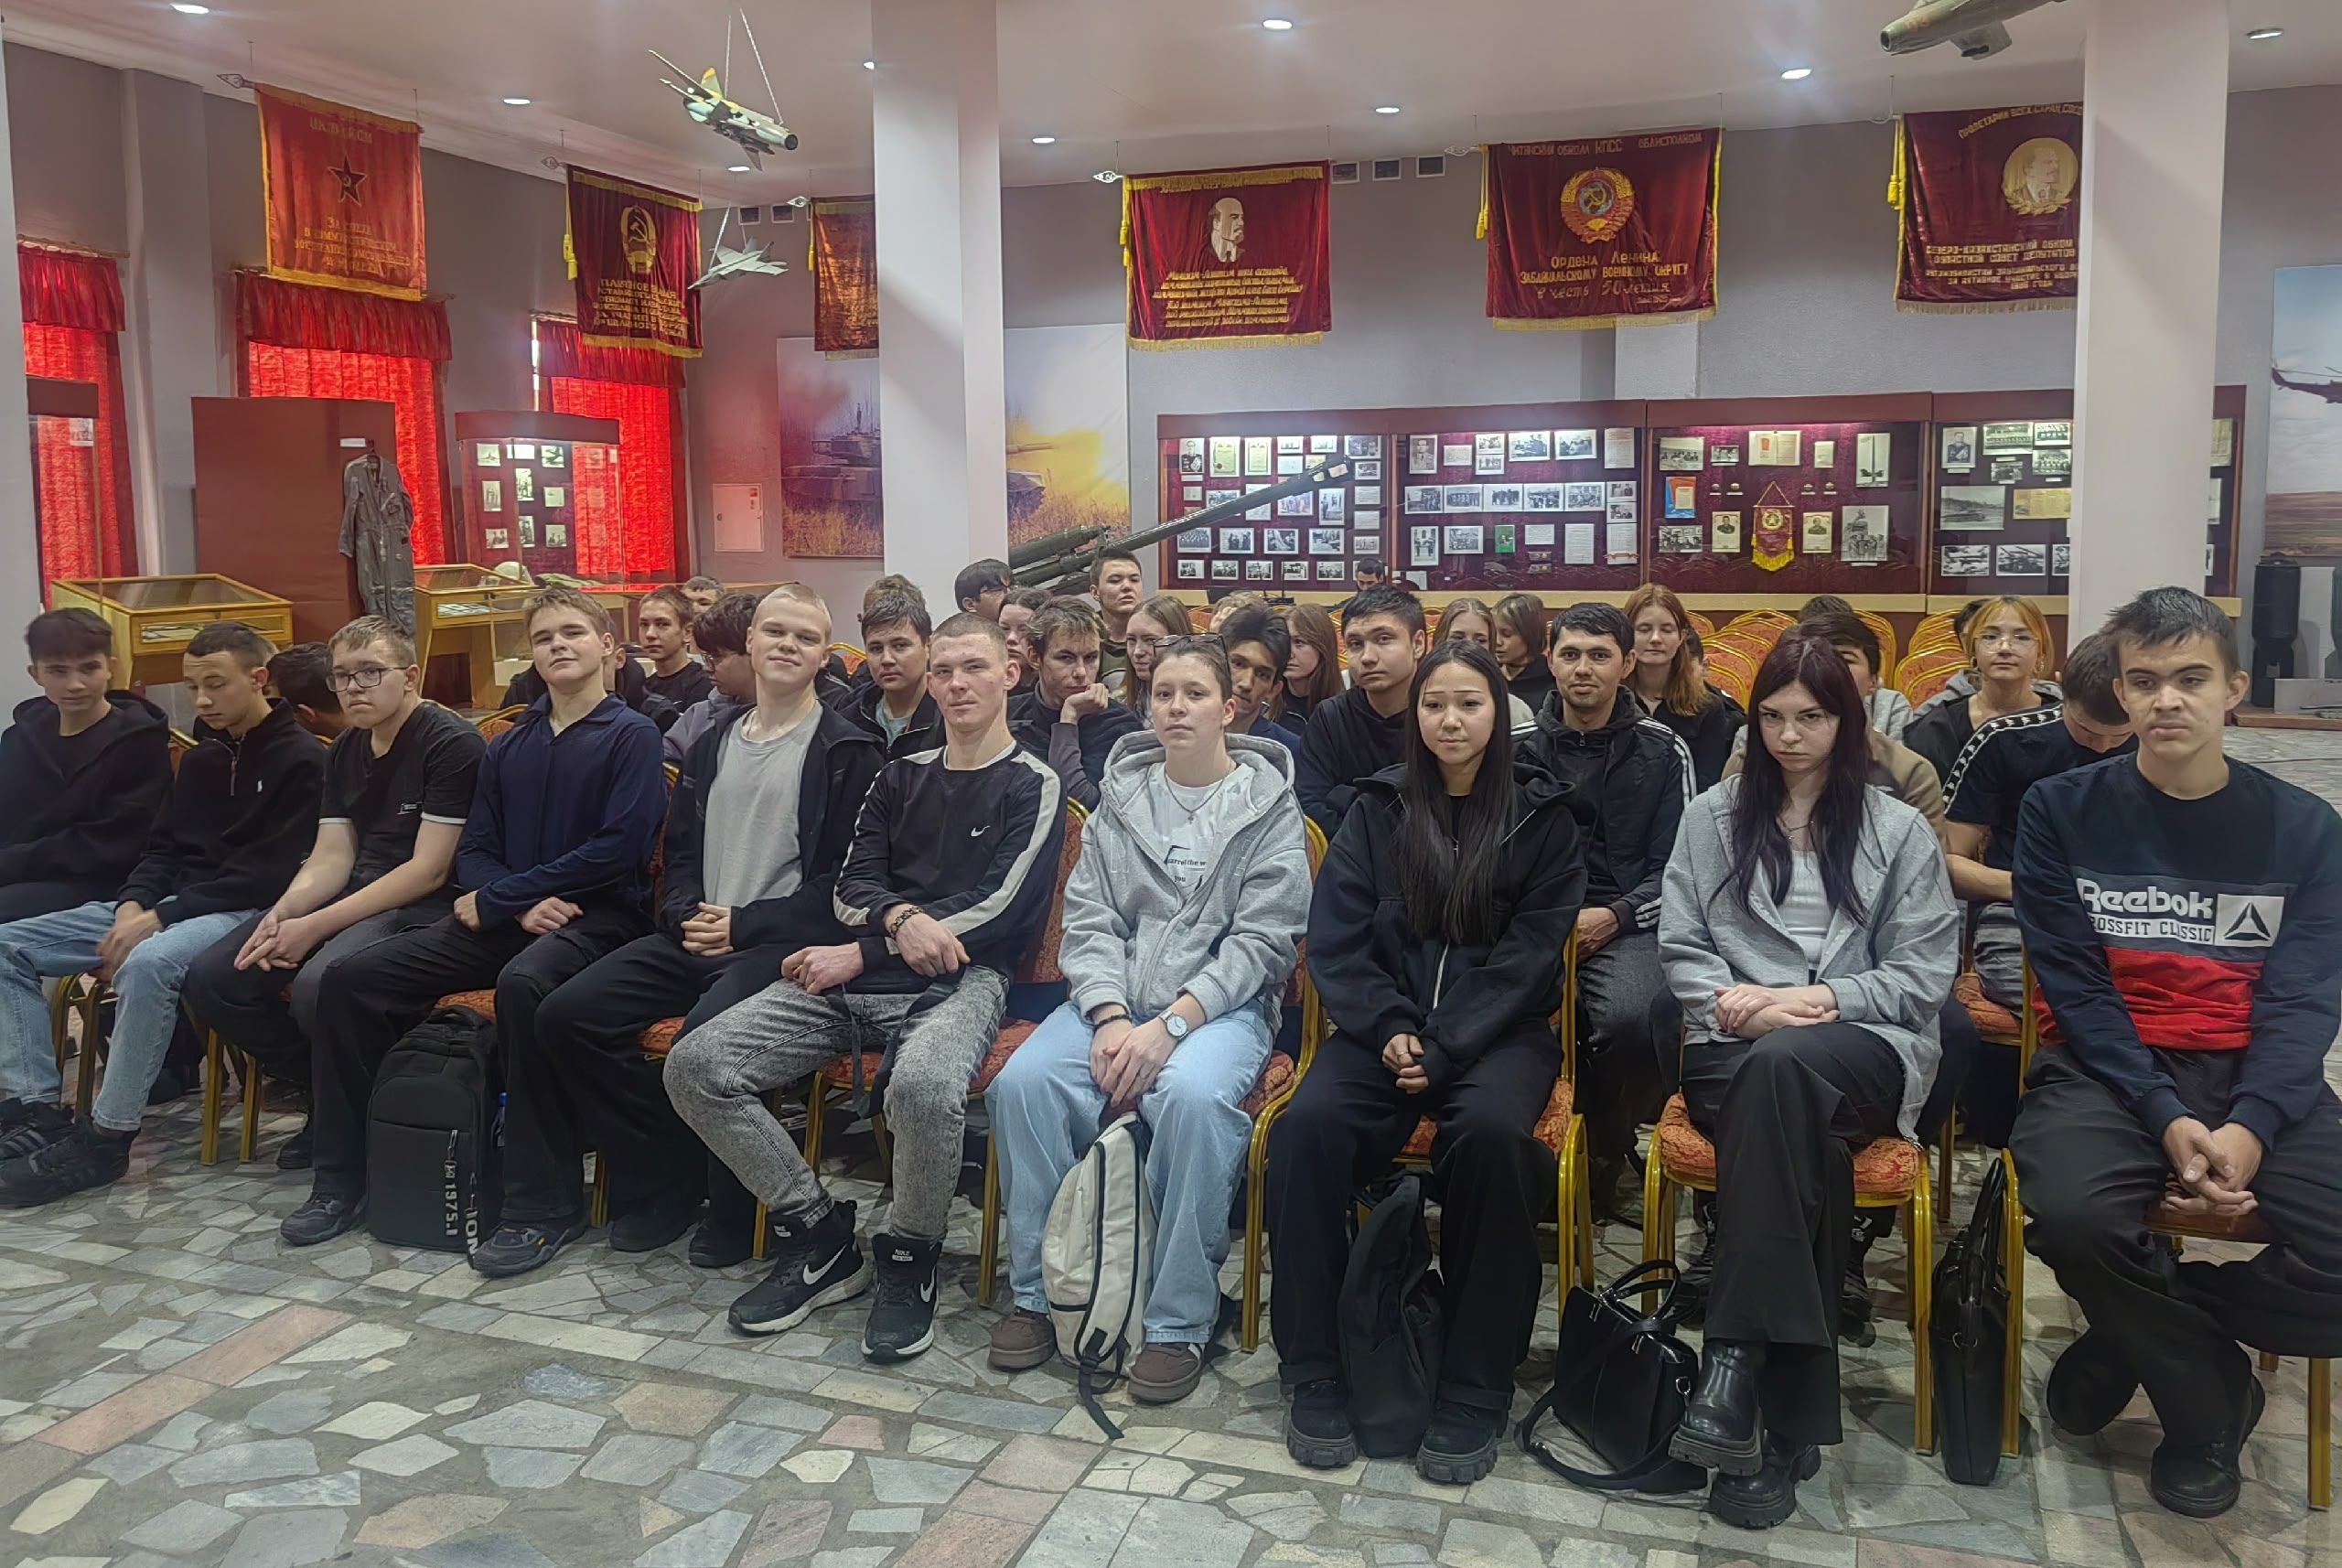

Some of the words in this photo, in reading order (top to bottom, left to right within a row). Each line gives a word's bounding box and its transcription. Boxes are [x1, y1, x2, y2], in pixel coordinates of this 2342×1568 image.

[1595, 139, 1623, 154] КПСС
[1990, 252, 2018, 263] СОВЕТ
[2023, 249, 2076, 261] ДЕПУТАТОВ
[2076, 877, 2214, 918] Reebok
